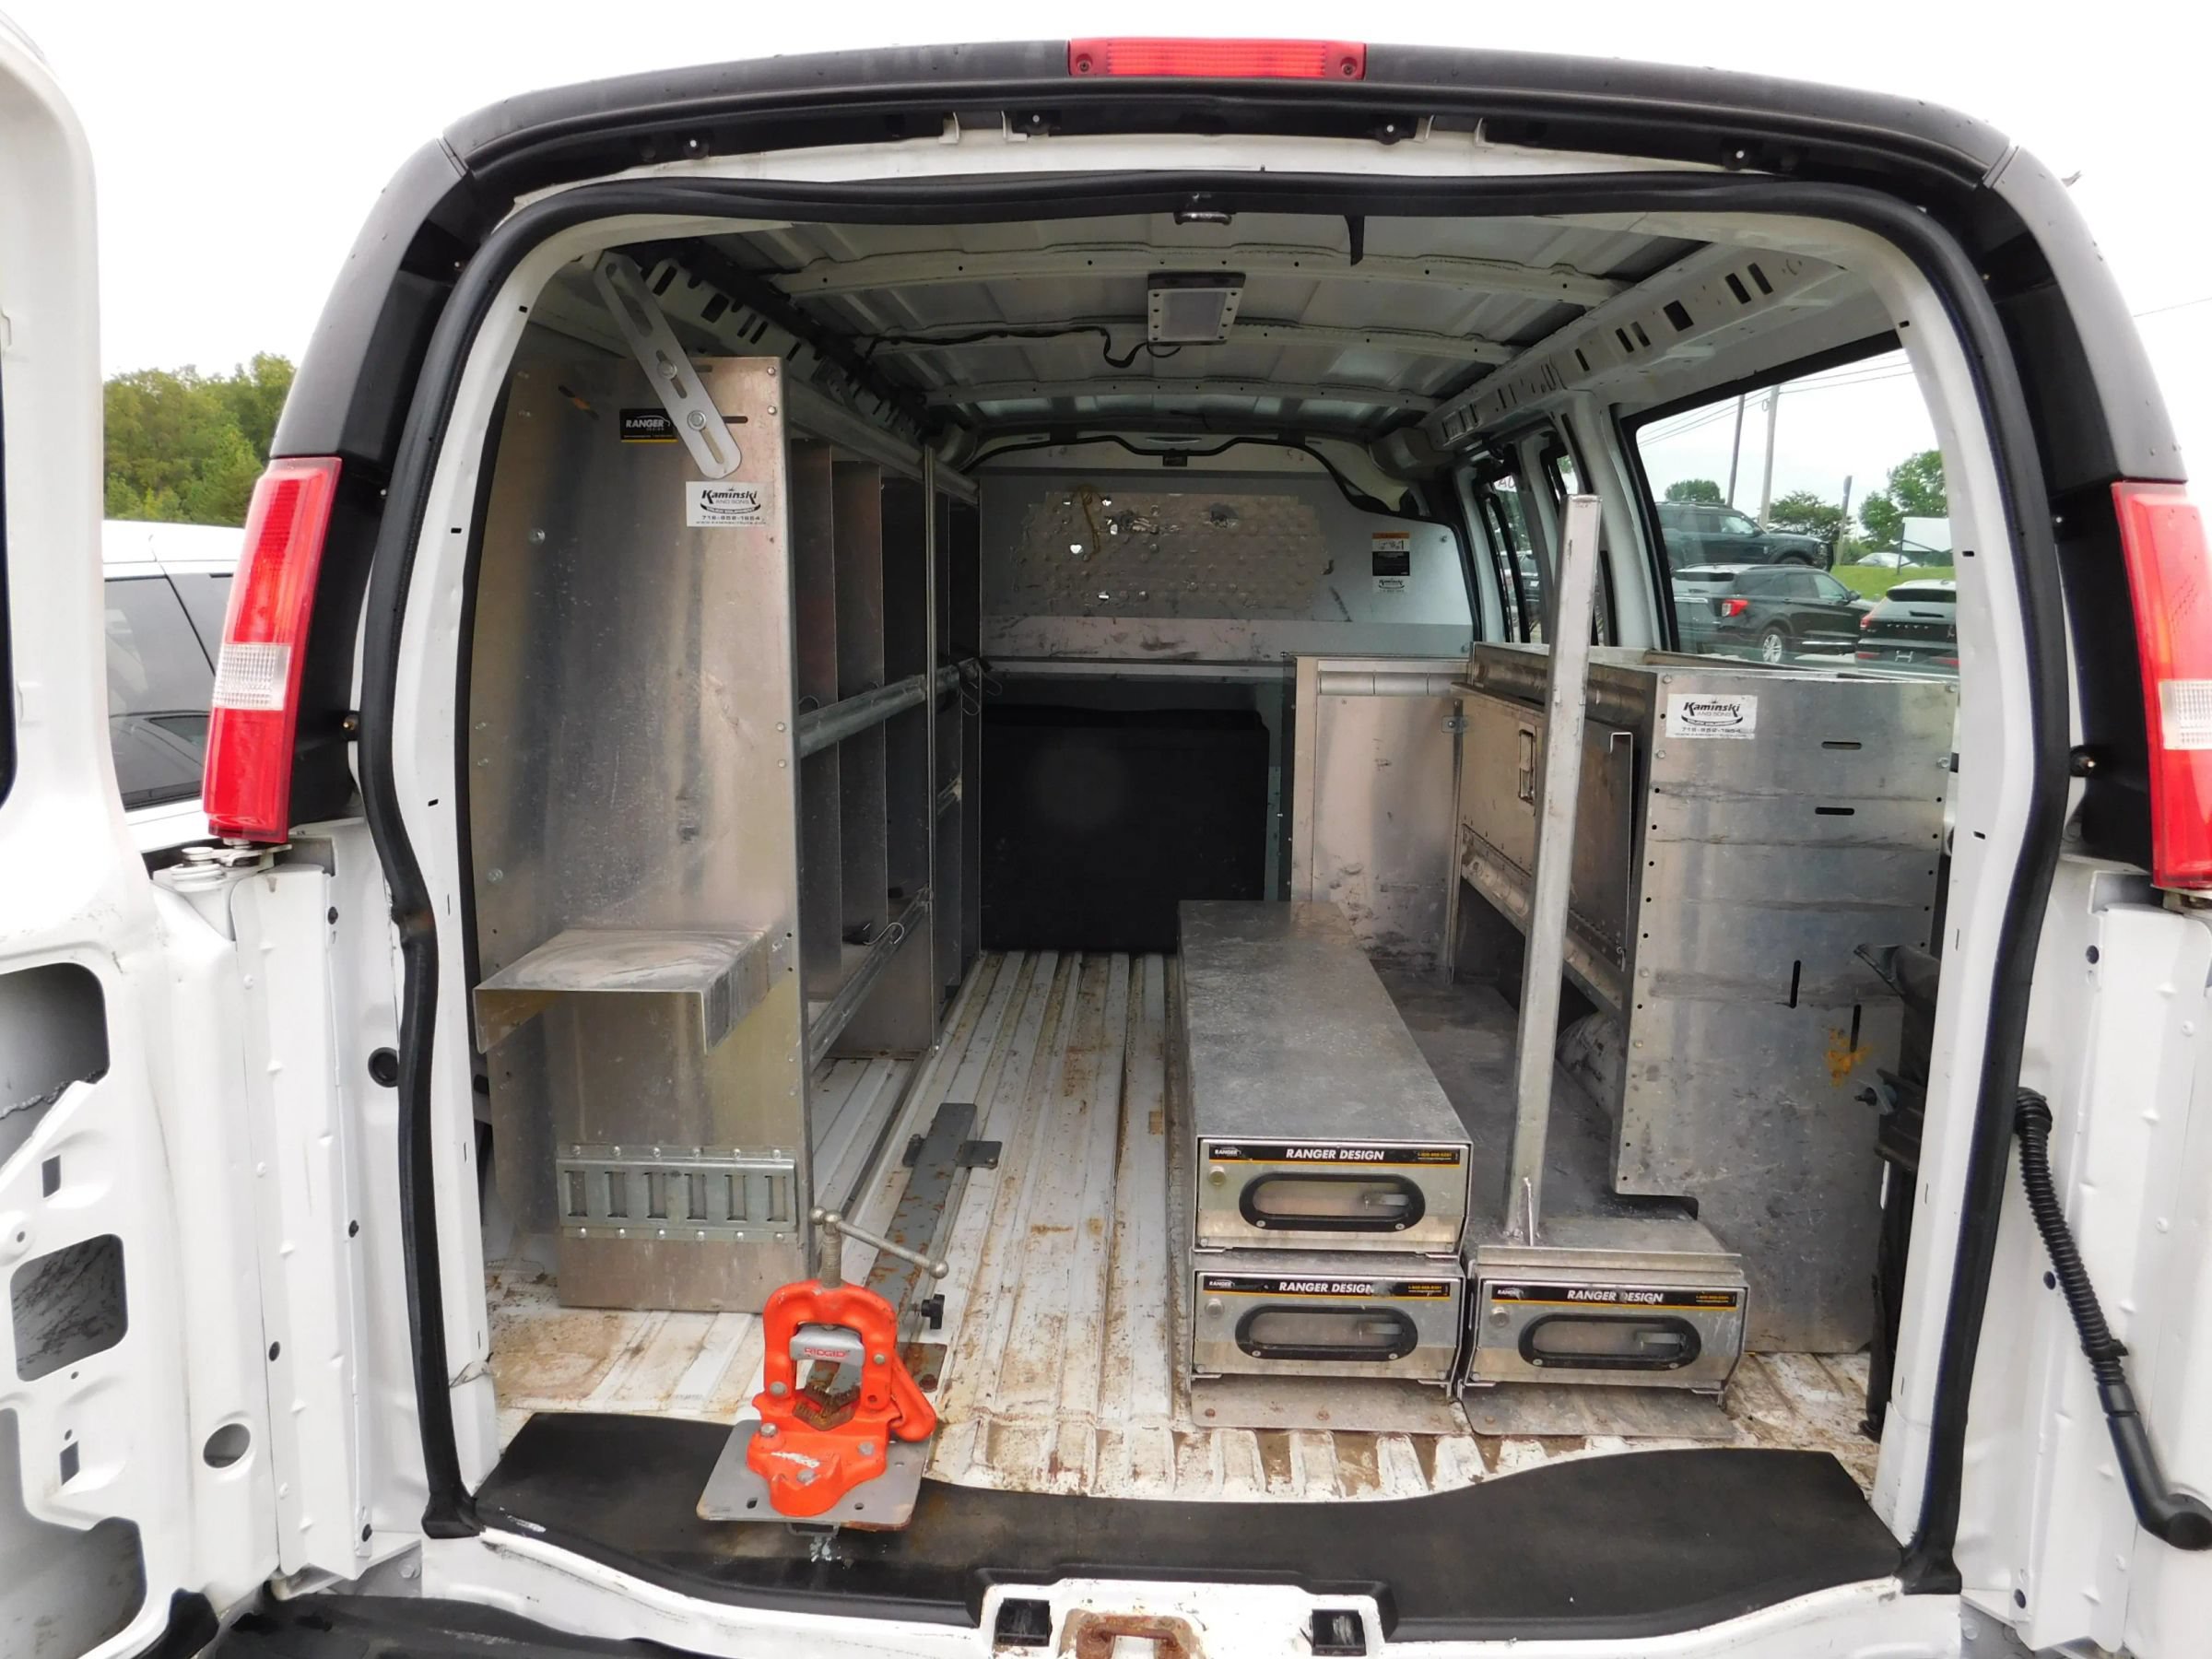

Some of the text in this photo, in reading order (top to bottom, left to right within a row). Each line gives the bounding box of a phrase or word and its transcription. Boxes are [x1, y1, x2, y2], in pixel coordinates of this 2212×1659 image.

[626, 419, 665, 428] RANGER
[701, 489, 758, 504] Kaminski
[1683, 702, 1740, 717] Kaminski
[1286, 1148, 1335, 1159] RANGER
[1339, 1149, 1384, 1160] DESIGN
[1279, 1282, 1328, 1292] RANGER
[1567, 1289, 1616, 1300] RANGER
[805, 1347, 846, 1357] RIDGID
